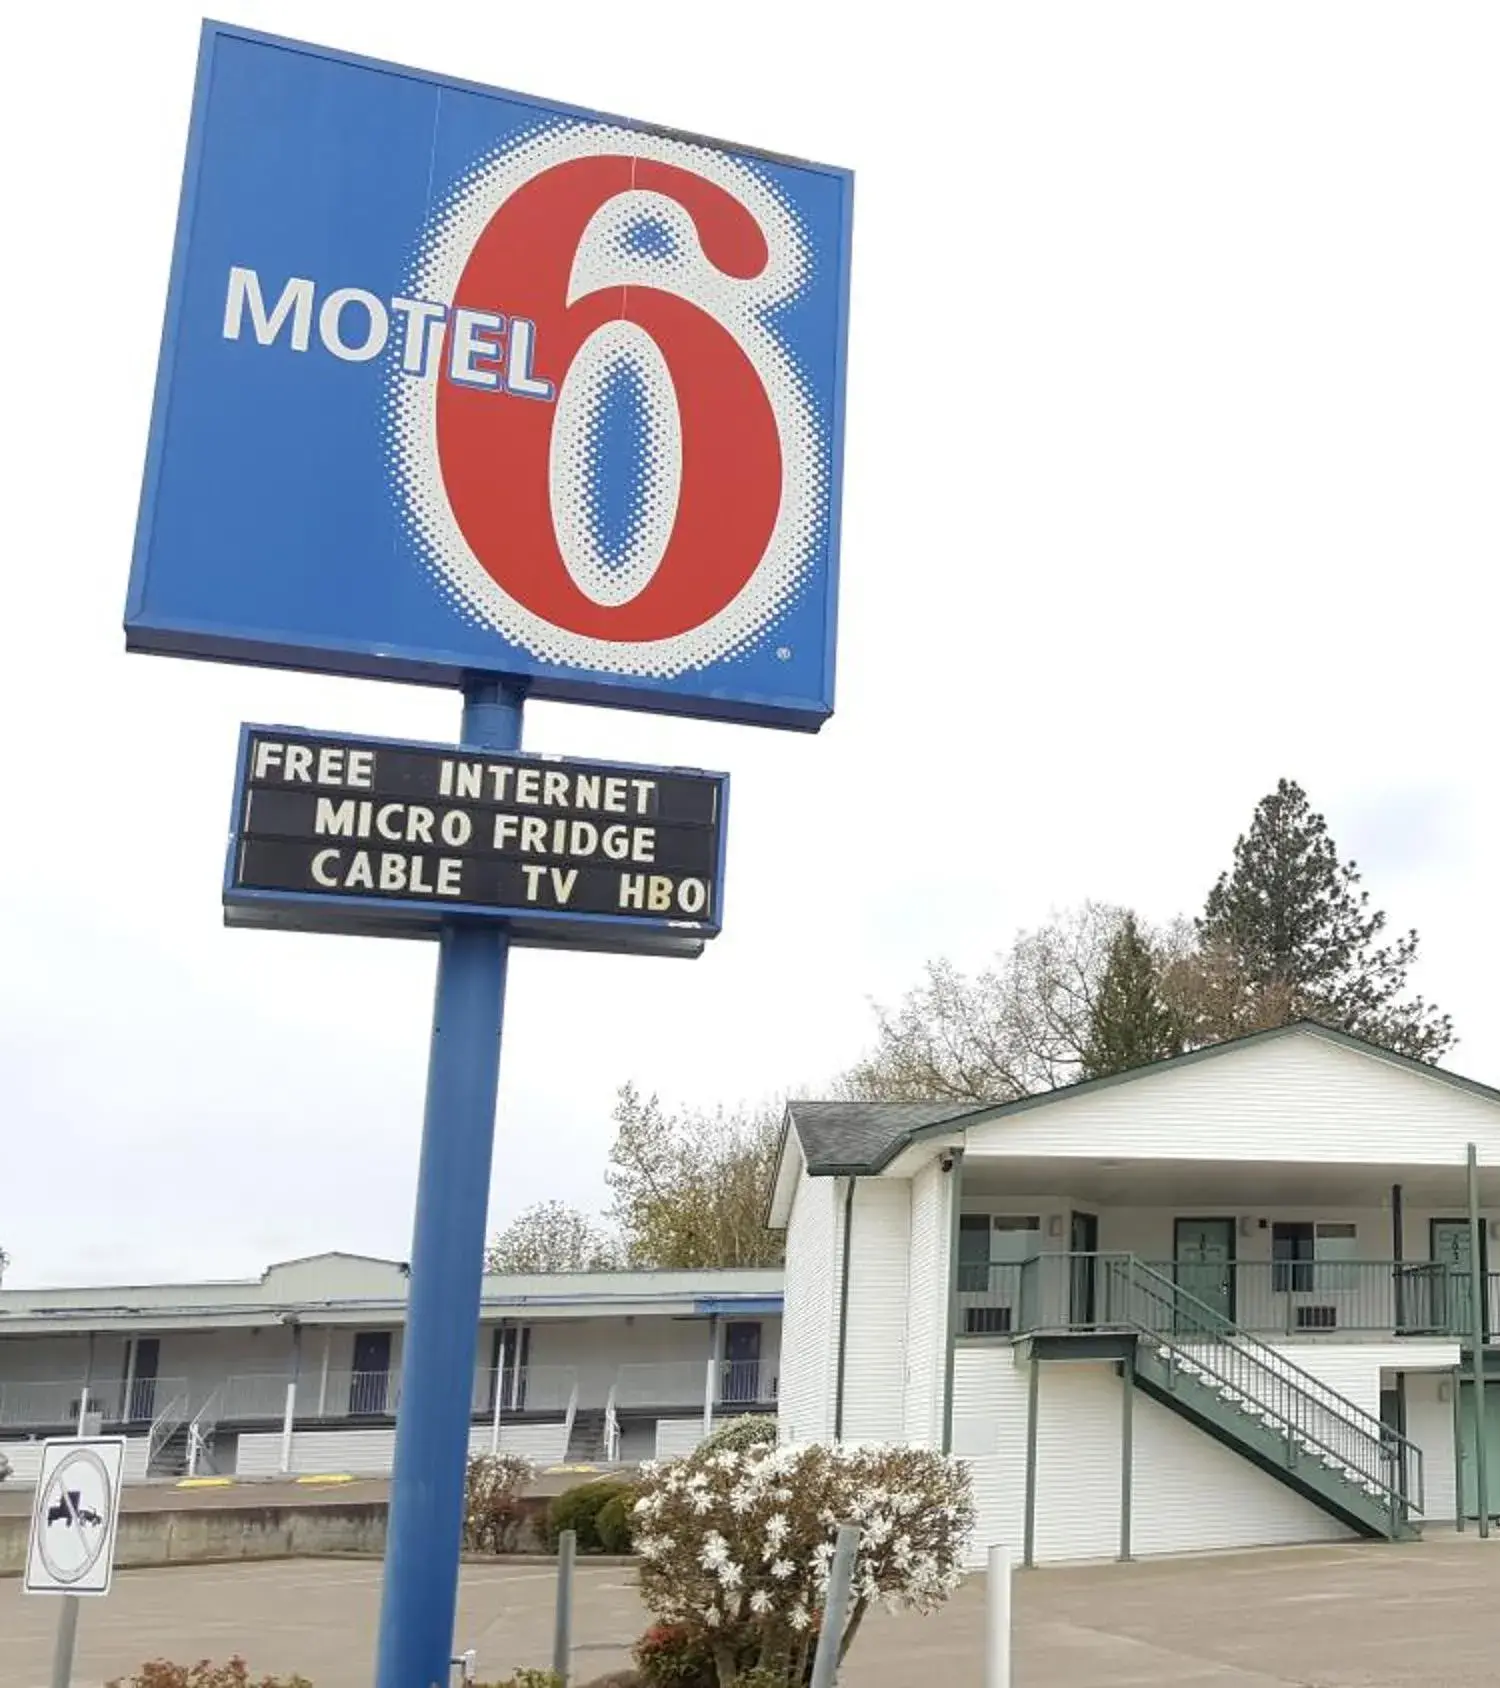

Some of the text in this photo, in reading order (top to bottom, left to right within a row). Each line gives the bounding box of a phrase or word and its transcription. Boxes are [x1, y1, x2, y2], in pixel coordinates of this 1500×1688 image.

[222, 153, 783, 643] MOTEL 6
[253, 741, 656, 815] FREE INTERNET
[314, 798, 656, 862] MICRO FRIDGE
[311, 848, 706, 913] CABLE TV HBO
